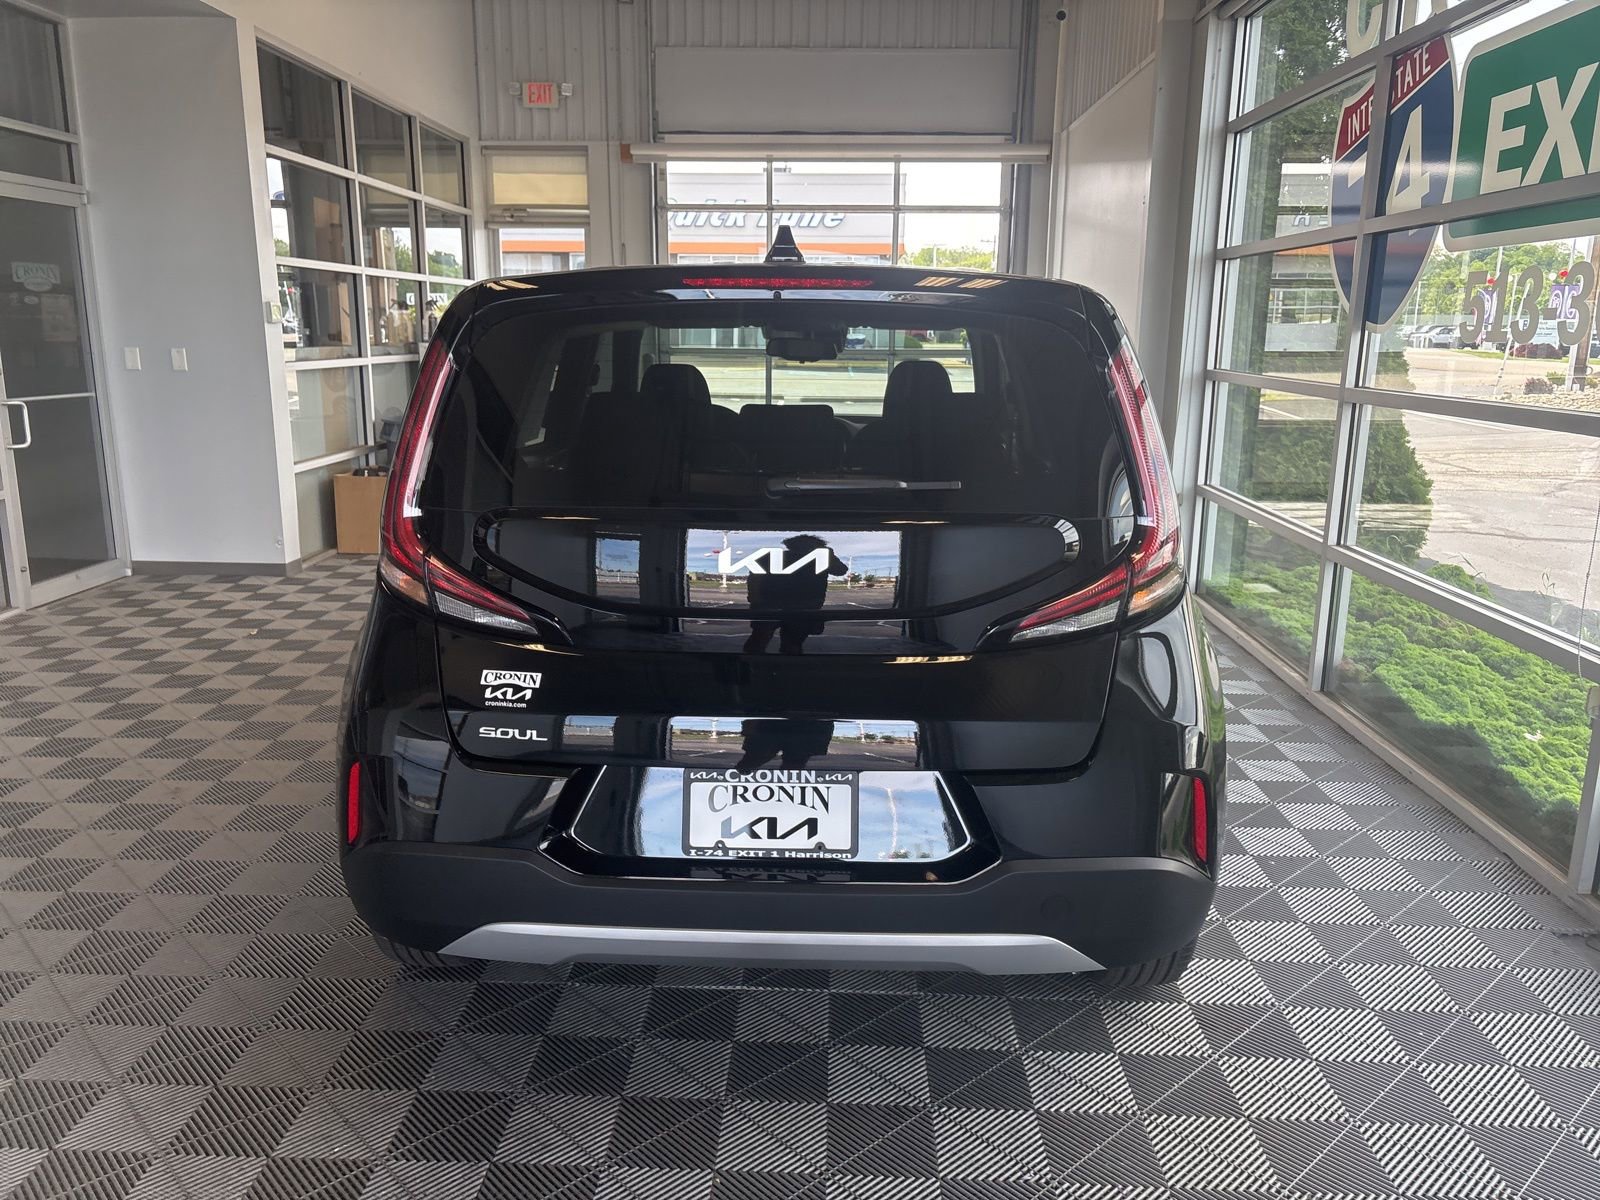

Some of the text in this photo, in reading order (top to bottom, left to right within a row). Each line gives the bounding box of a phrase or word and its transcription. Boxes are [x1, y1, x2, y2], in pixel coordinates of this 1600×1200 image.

[527, 82, 553, 104] EXIT
[1459, 260, 1600, 346] 513-3
[718, 547, 830, 574] KIA
[484, 671, 539, 687] CRONIN
[484, 686, 533, 700] KIA
[485, 700, 527, 708] croninkia.com
[479, 726, 548, 741] SOUL
[724, 768, 816, 783] CRONIN
[708, 784, 832, 815] CRONIN
[721, 816, 818, 840] KIA
[689, 849, 724, 857] I-74
[770, 850, 780, 858] 1
[784, 850, 852, 859] Harrison
